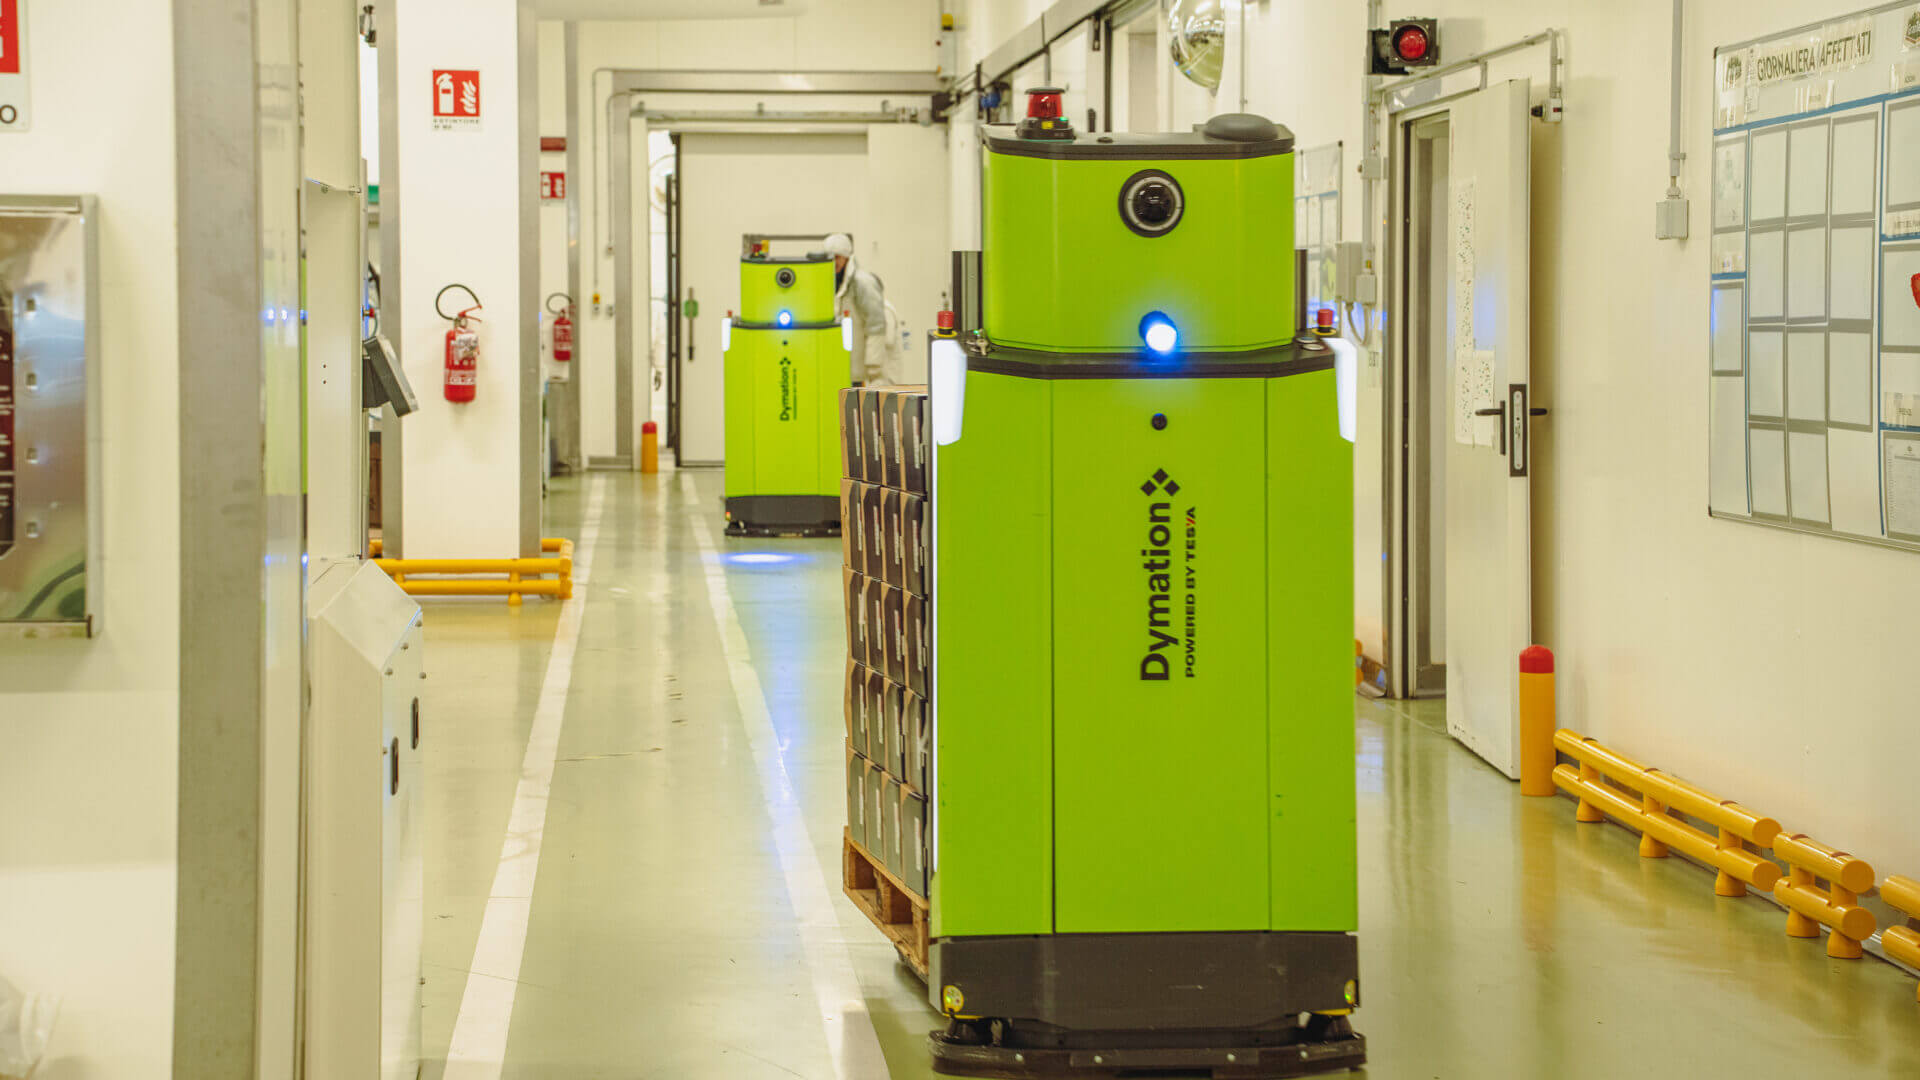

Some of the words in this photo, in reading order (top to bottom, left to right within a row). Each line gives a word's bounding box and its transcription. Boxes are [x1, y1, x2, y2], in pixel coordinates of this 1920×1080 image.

[1757, 48, 1815, 81] GIORNALIERA
[1821, 31, 1872, 66] AFFETTATI
[779, 368, 792, 421] Dymation
[1140, 503, 1179, 680] Dymation
[1186, 566, 1196, 589] BY
[1186, 594, 1196, 678] POWERED
